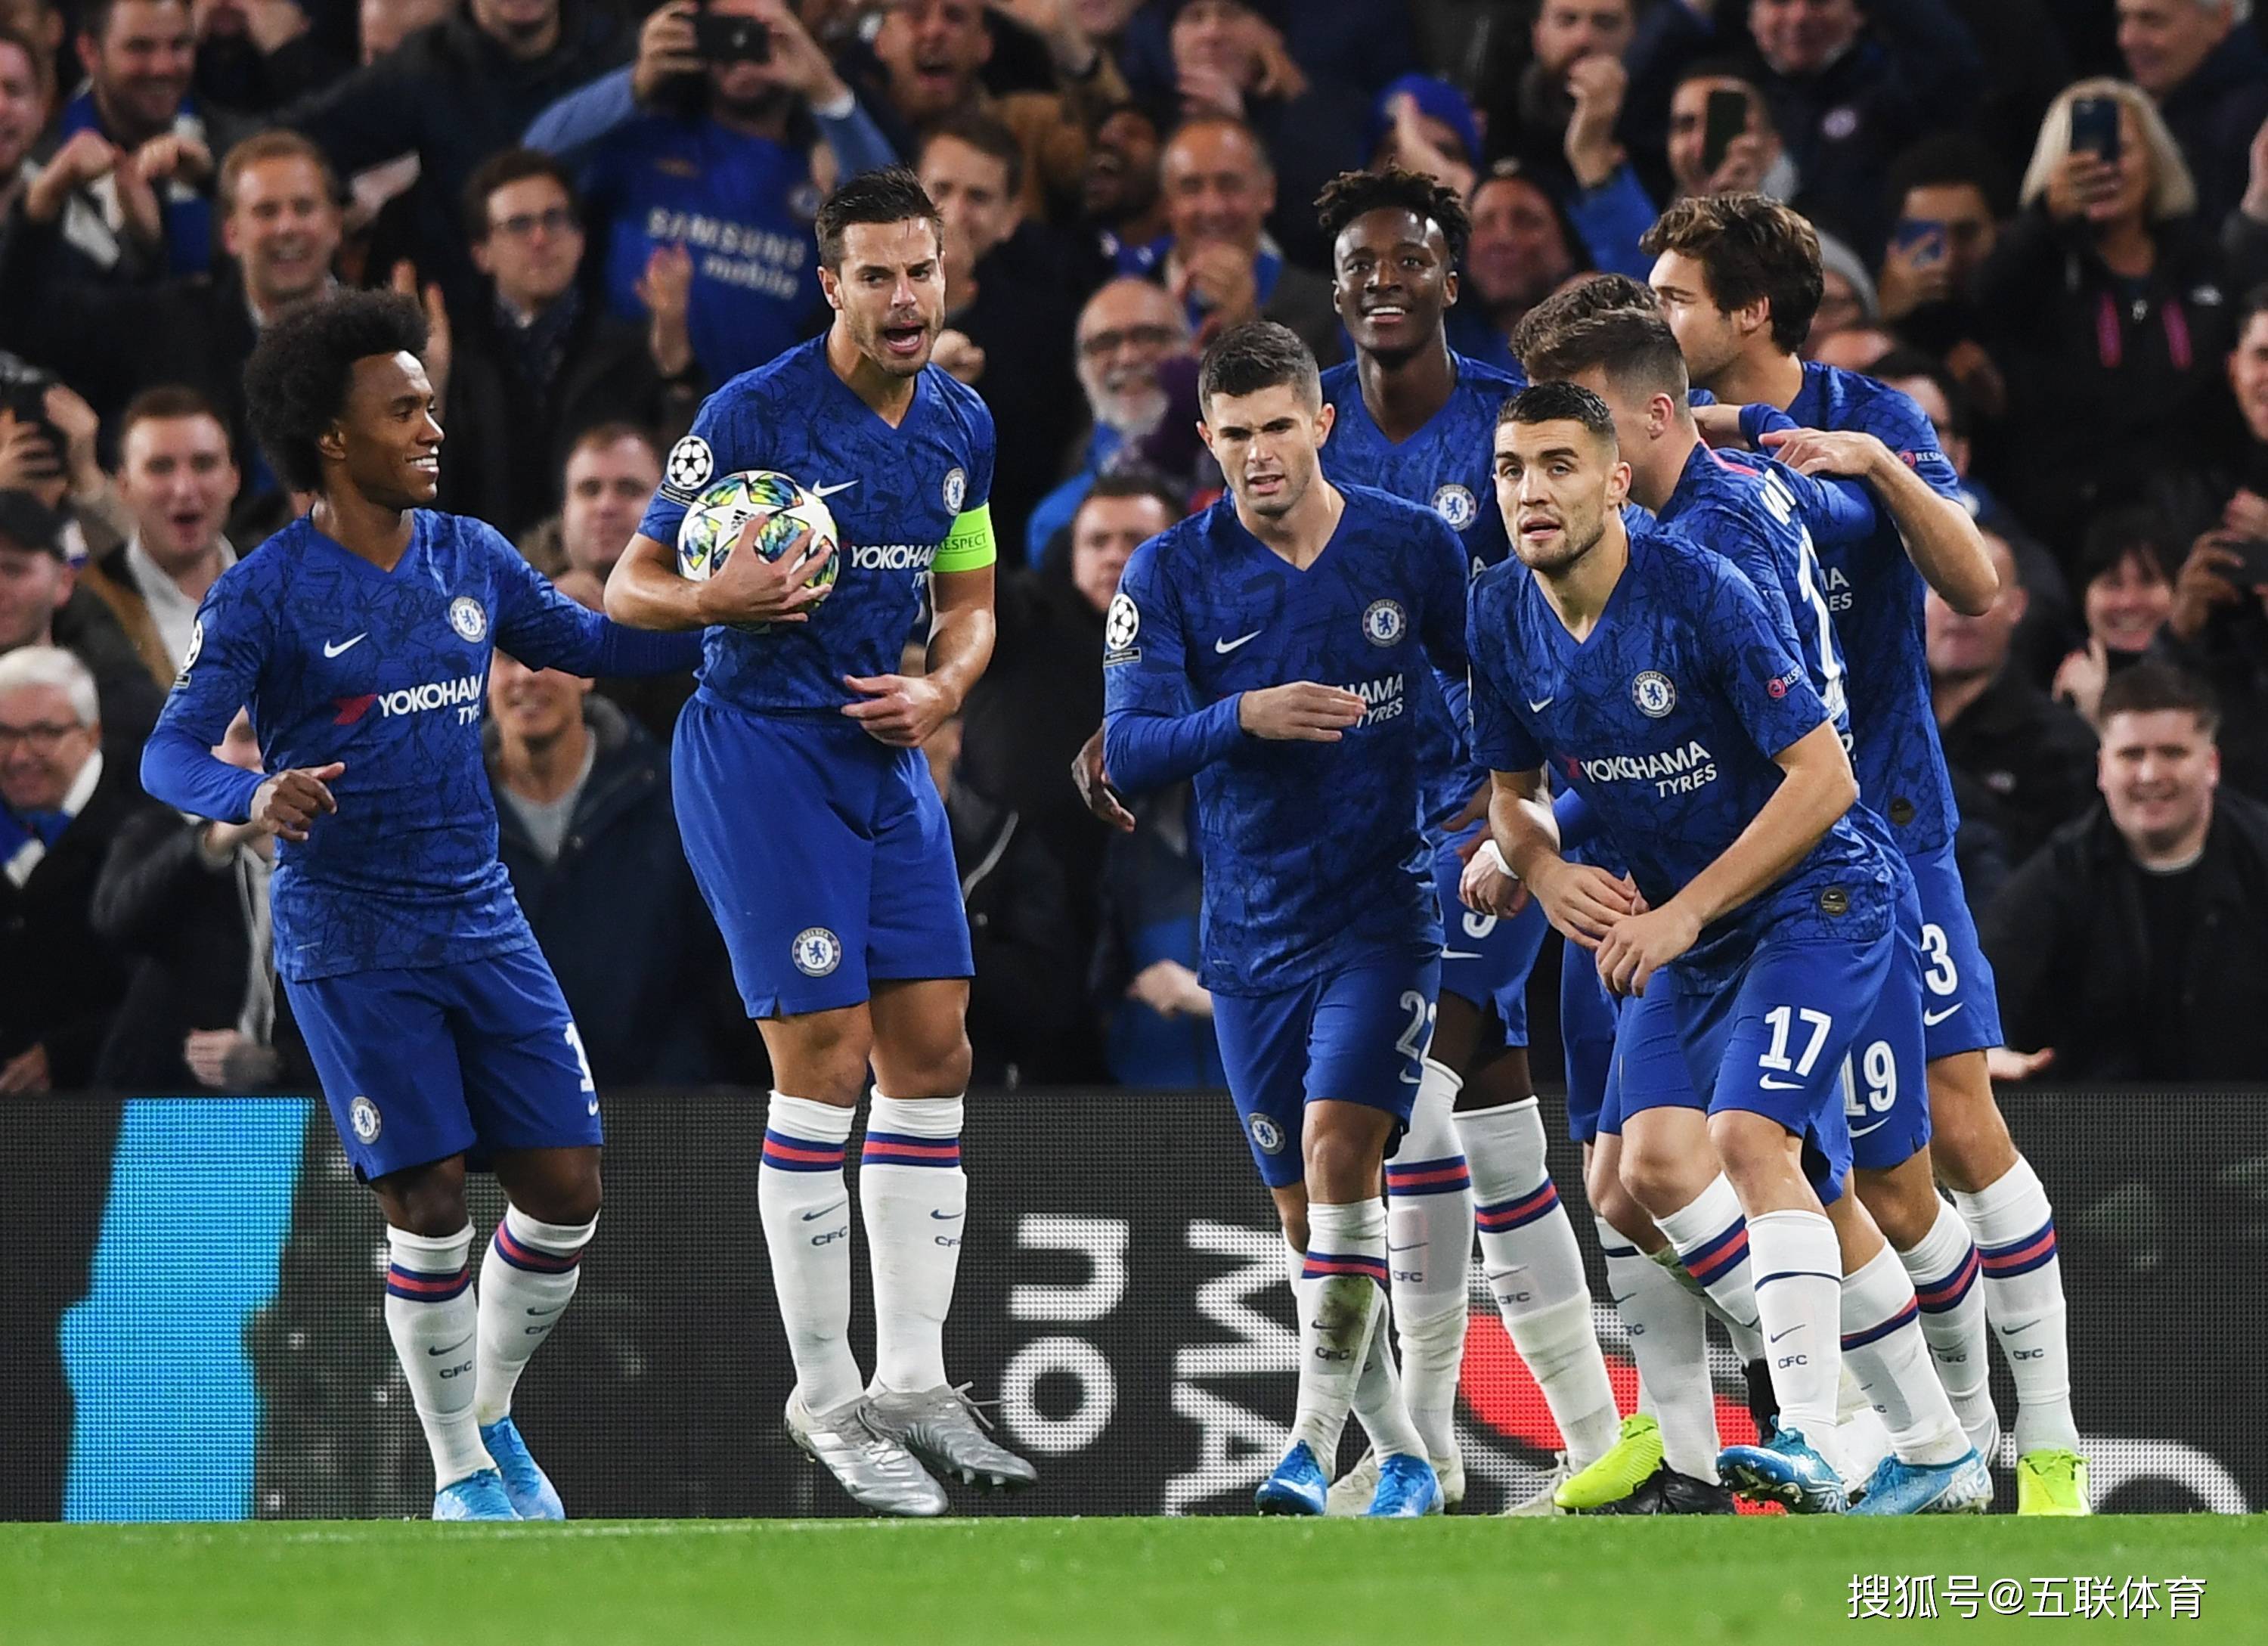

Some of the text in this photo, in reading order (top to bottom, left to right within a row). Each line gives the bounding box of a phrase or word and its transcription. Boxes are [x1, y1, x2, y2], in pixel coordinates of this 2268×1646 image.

[648, 207, 806, 268] SAMSUNG
[704, 254, 798, 299] mobile
[378, 672, 484, 718] YOKOHAM
[1580, 741, 1711, 783] YOKOHAMA
[1655, 763, 1718, 798] TYRES
[1758, 1006, 1832, 1077] 17
[1842, 1040, 1897, 1112] 19
[1393, 1270, 1424, 1283] CFC
[1498, 1291, 1530, 1305] CFC
[1625, 1323, 1653, 1335] FC
[439, 1360, 472, 1379] CFC
[1163, 1218, 1302, 1515] MA
[1315, 1346, 1350, 1360] CFC
[1777, 1354, 1808, 1369] CFC
[2012, 1348, 2044, 1360] CFC
